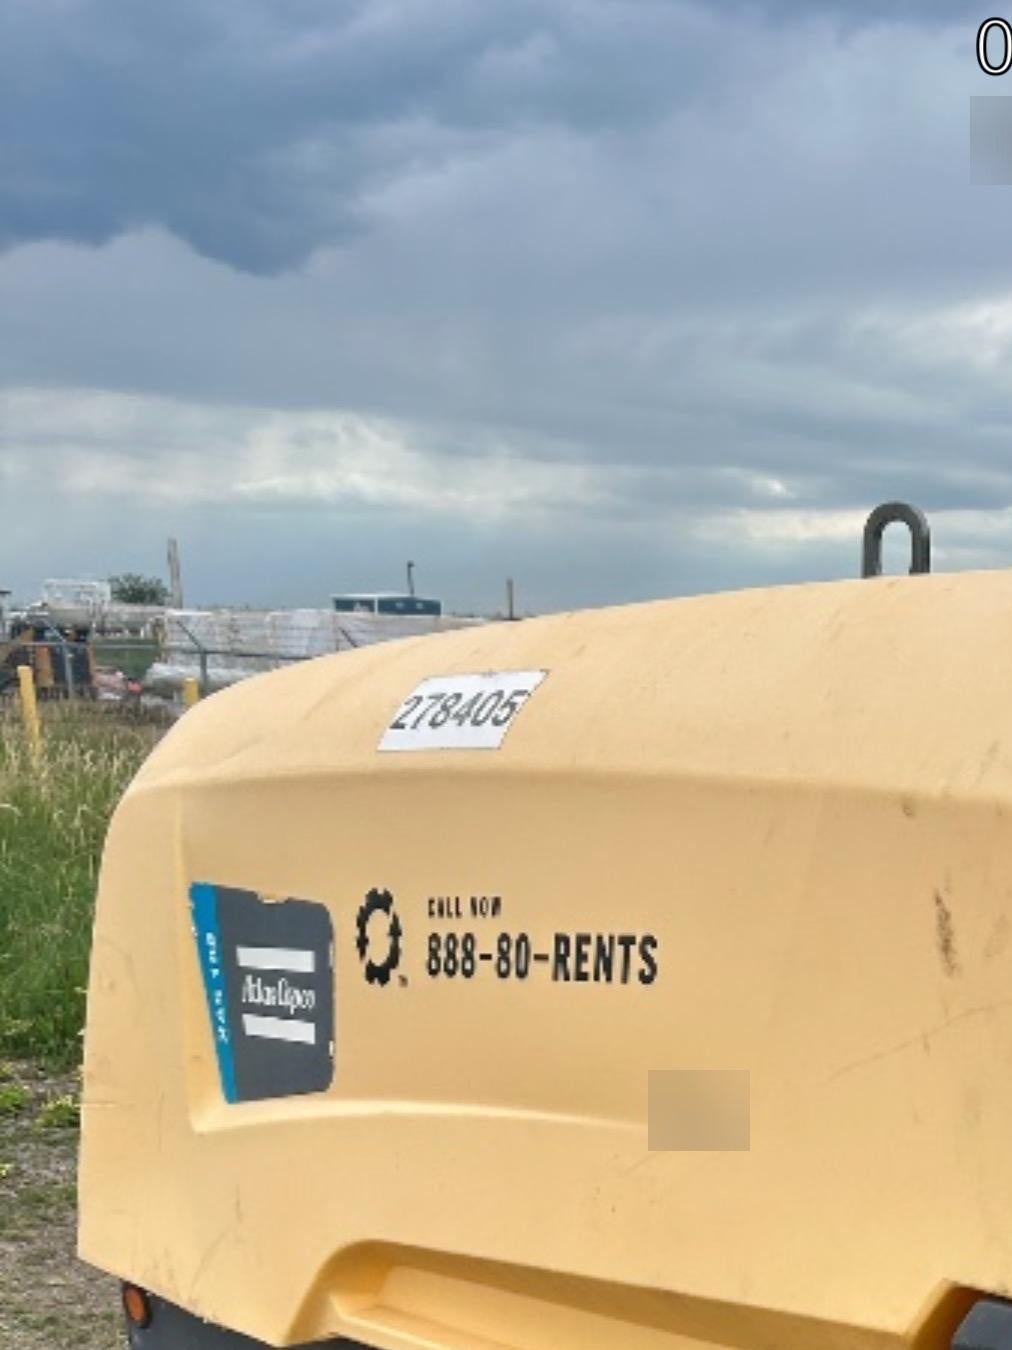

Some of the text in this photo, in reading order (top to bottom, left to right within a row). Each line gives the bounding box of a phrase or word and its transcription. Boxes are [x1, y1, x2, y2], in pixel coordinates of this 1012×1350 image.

[389, 689, 531, 729] 278405
[428, 896, 502, 918] CALL NOW
[426, 932, 659, 985] 888-80-RENTS
